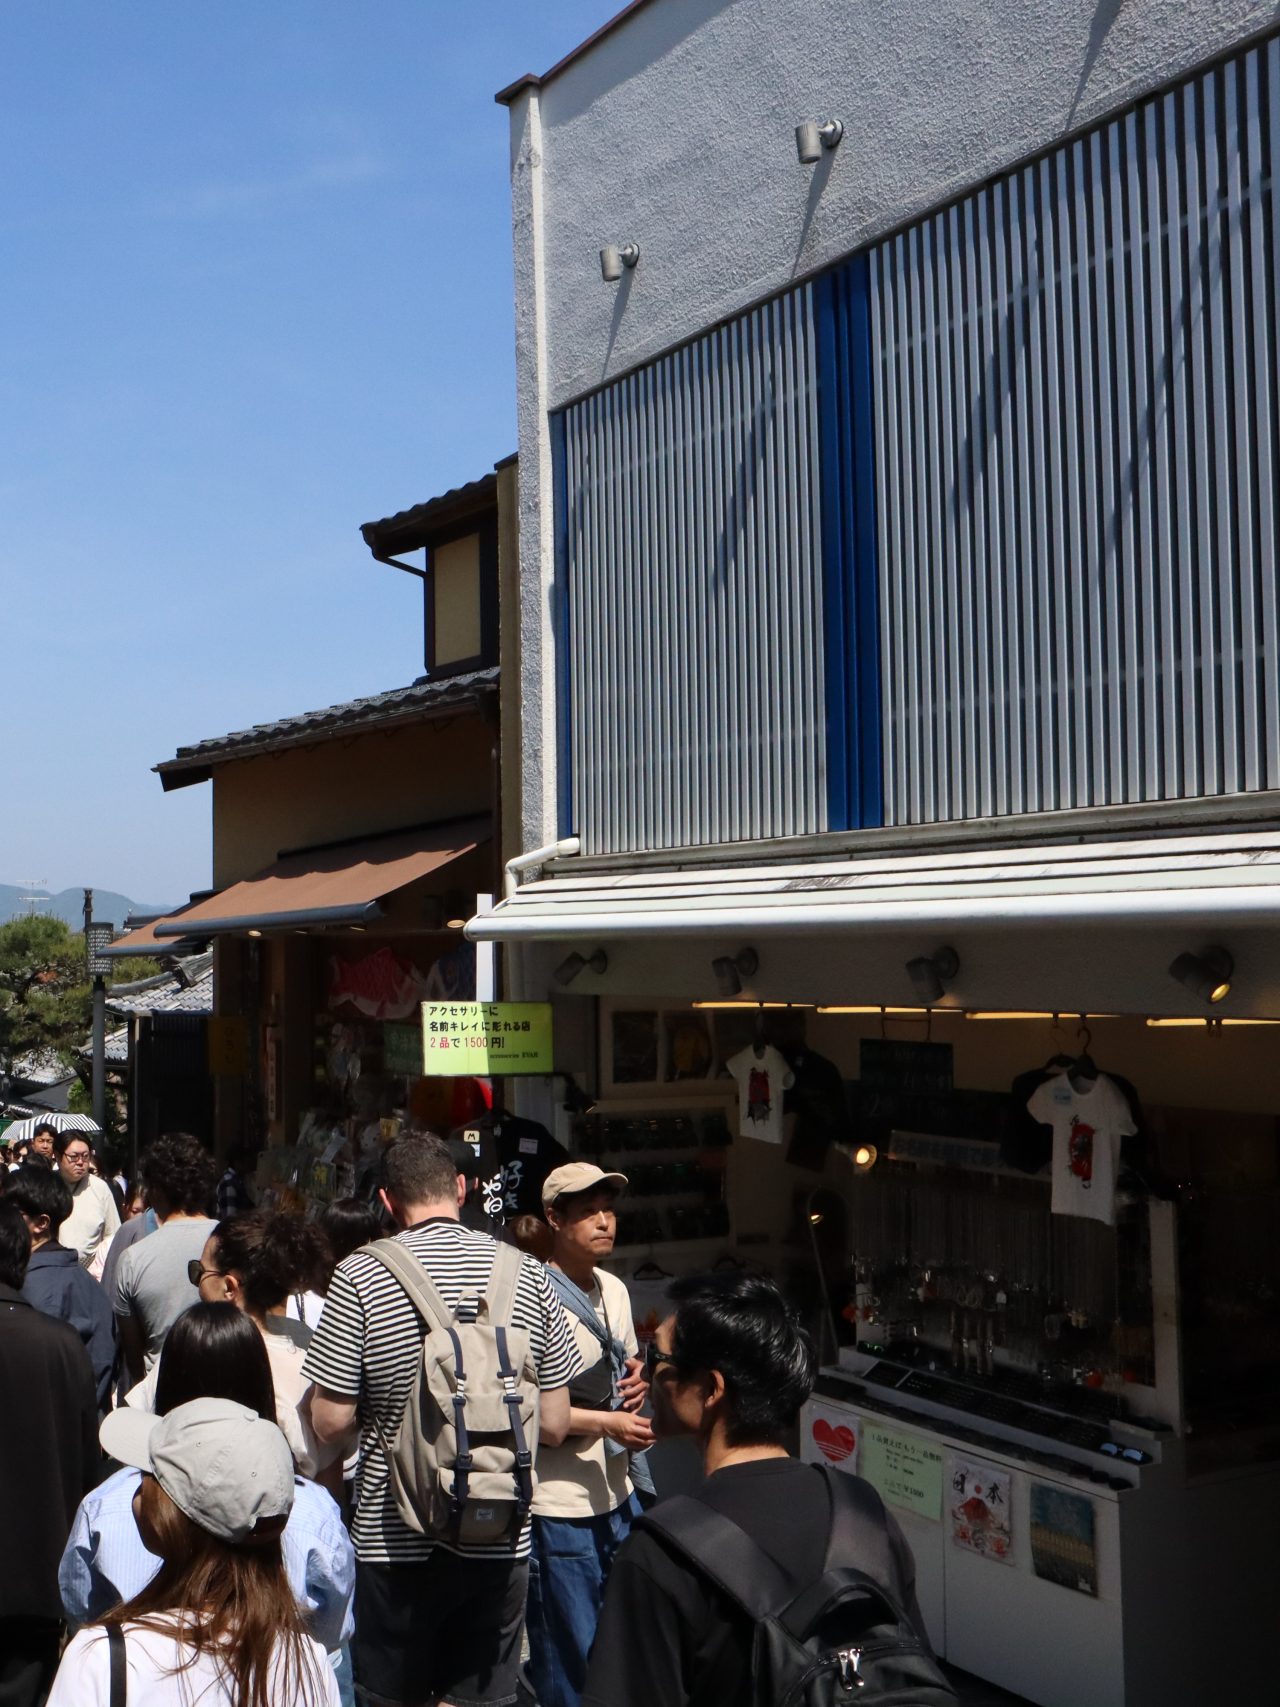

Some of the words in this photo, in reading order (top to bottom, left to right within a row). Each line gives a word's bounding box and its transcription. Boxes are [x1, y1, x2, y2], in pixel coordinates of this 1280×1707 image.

[429, 1006, 498, 1016] アクセサリーに
[952, 1470, 1004, 1505] 日本
